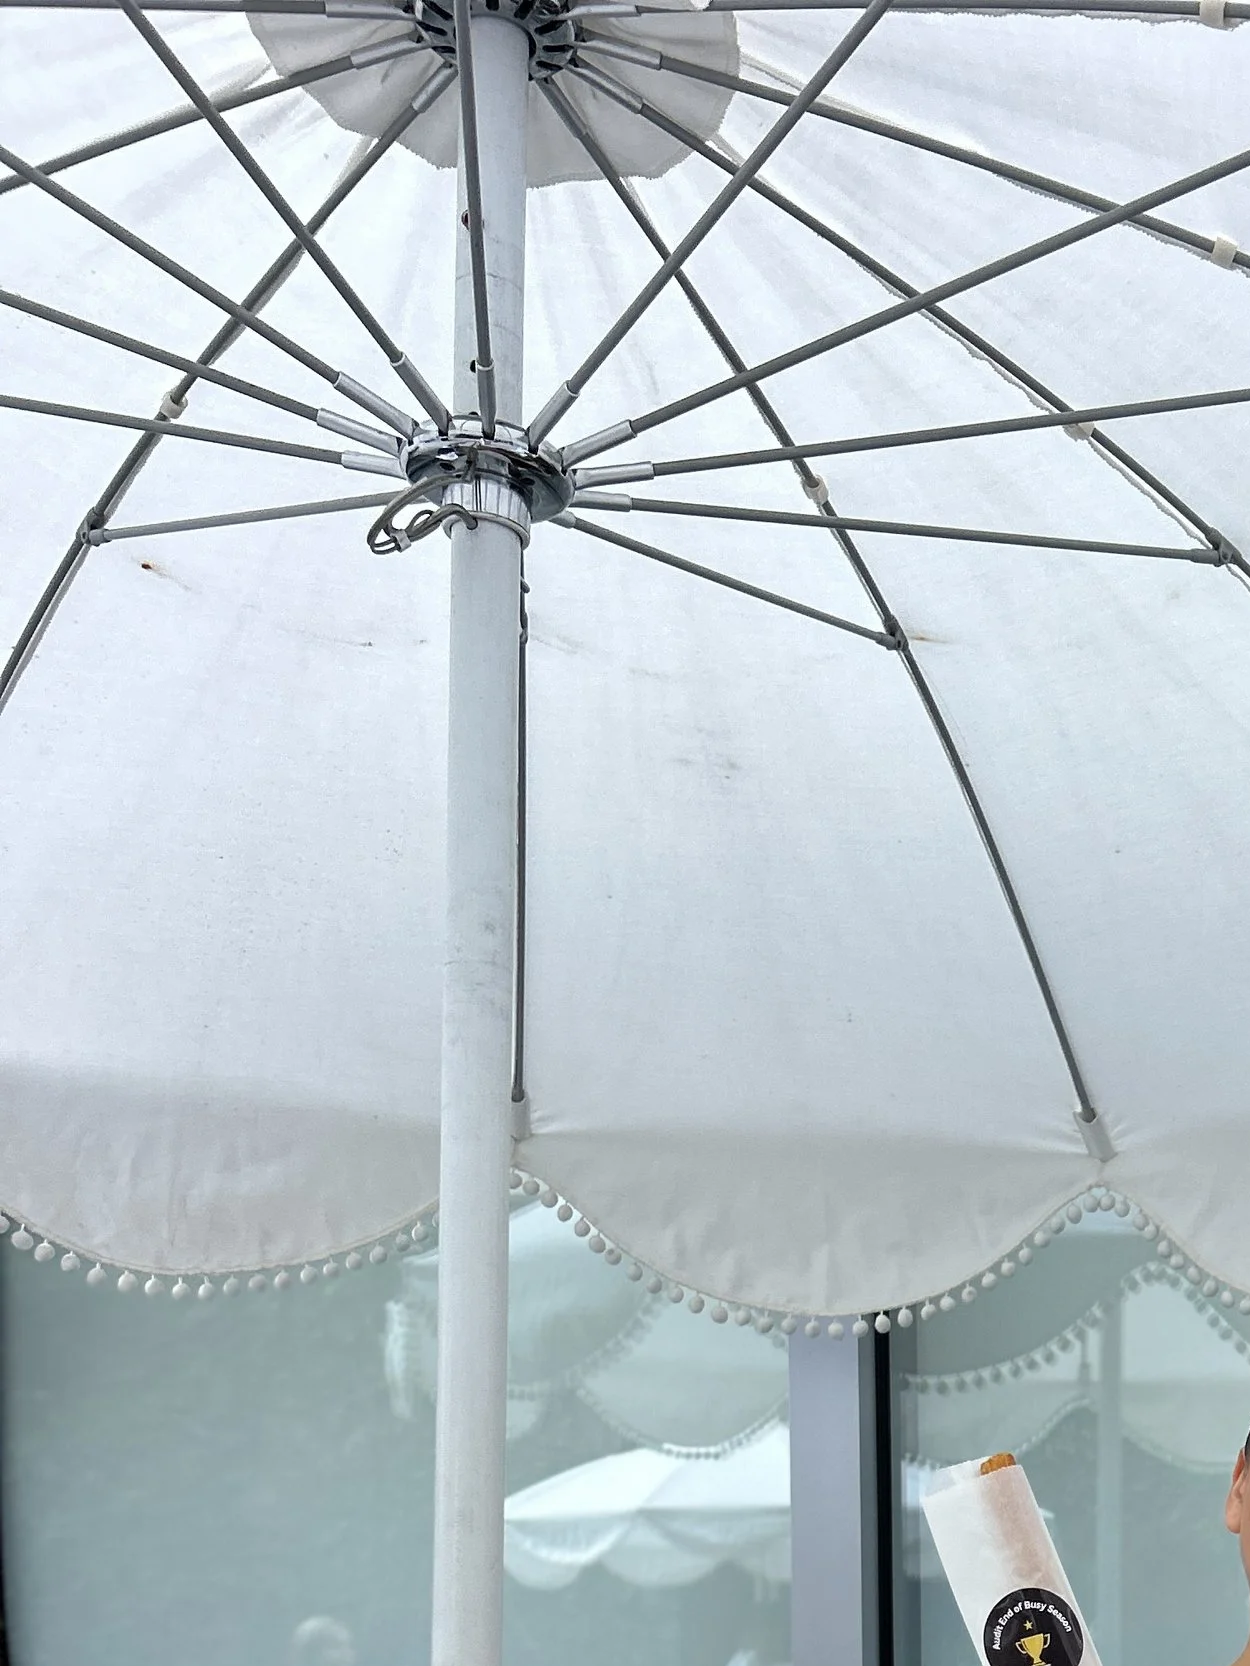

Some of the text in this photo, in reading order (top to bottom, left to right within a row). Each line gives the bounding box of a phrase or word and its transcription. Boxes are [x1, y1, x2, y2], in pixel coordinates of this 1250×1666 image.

[992, 1600, 1072, 1650] Audit End of Busy Season
